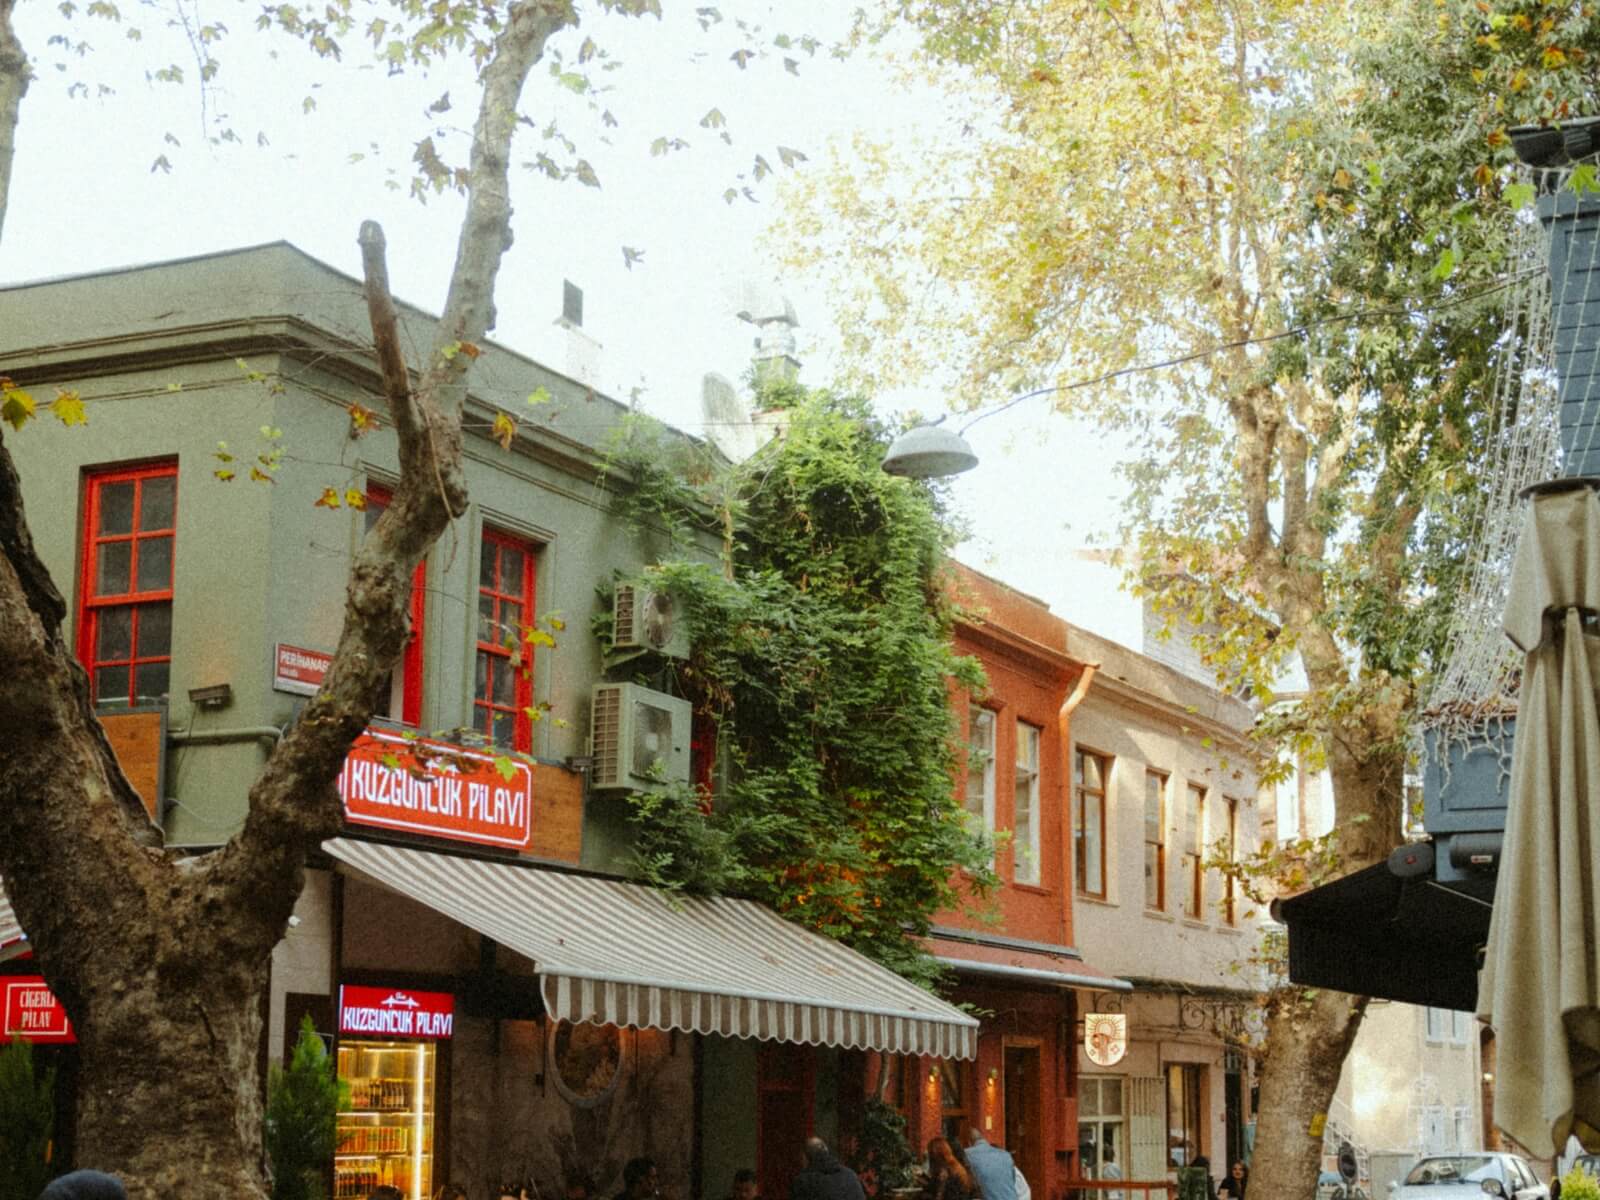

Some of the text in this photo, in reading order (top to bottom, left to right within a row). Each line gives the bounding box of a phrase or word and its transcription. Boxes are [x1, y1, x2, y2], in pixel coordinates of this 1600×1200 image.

[280, 650, 330, 673] PERİHANAB
[351, 759, 525, 828] KUZGUNCUK PİLAVI
[342, 1006, 414, 1034] KUZGUNCUK
